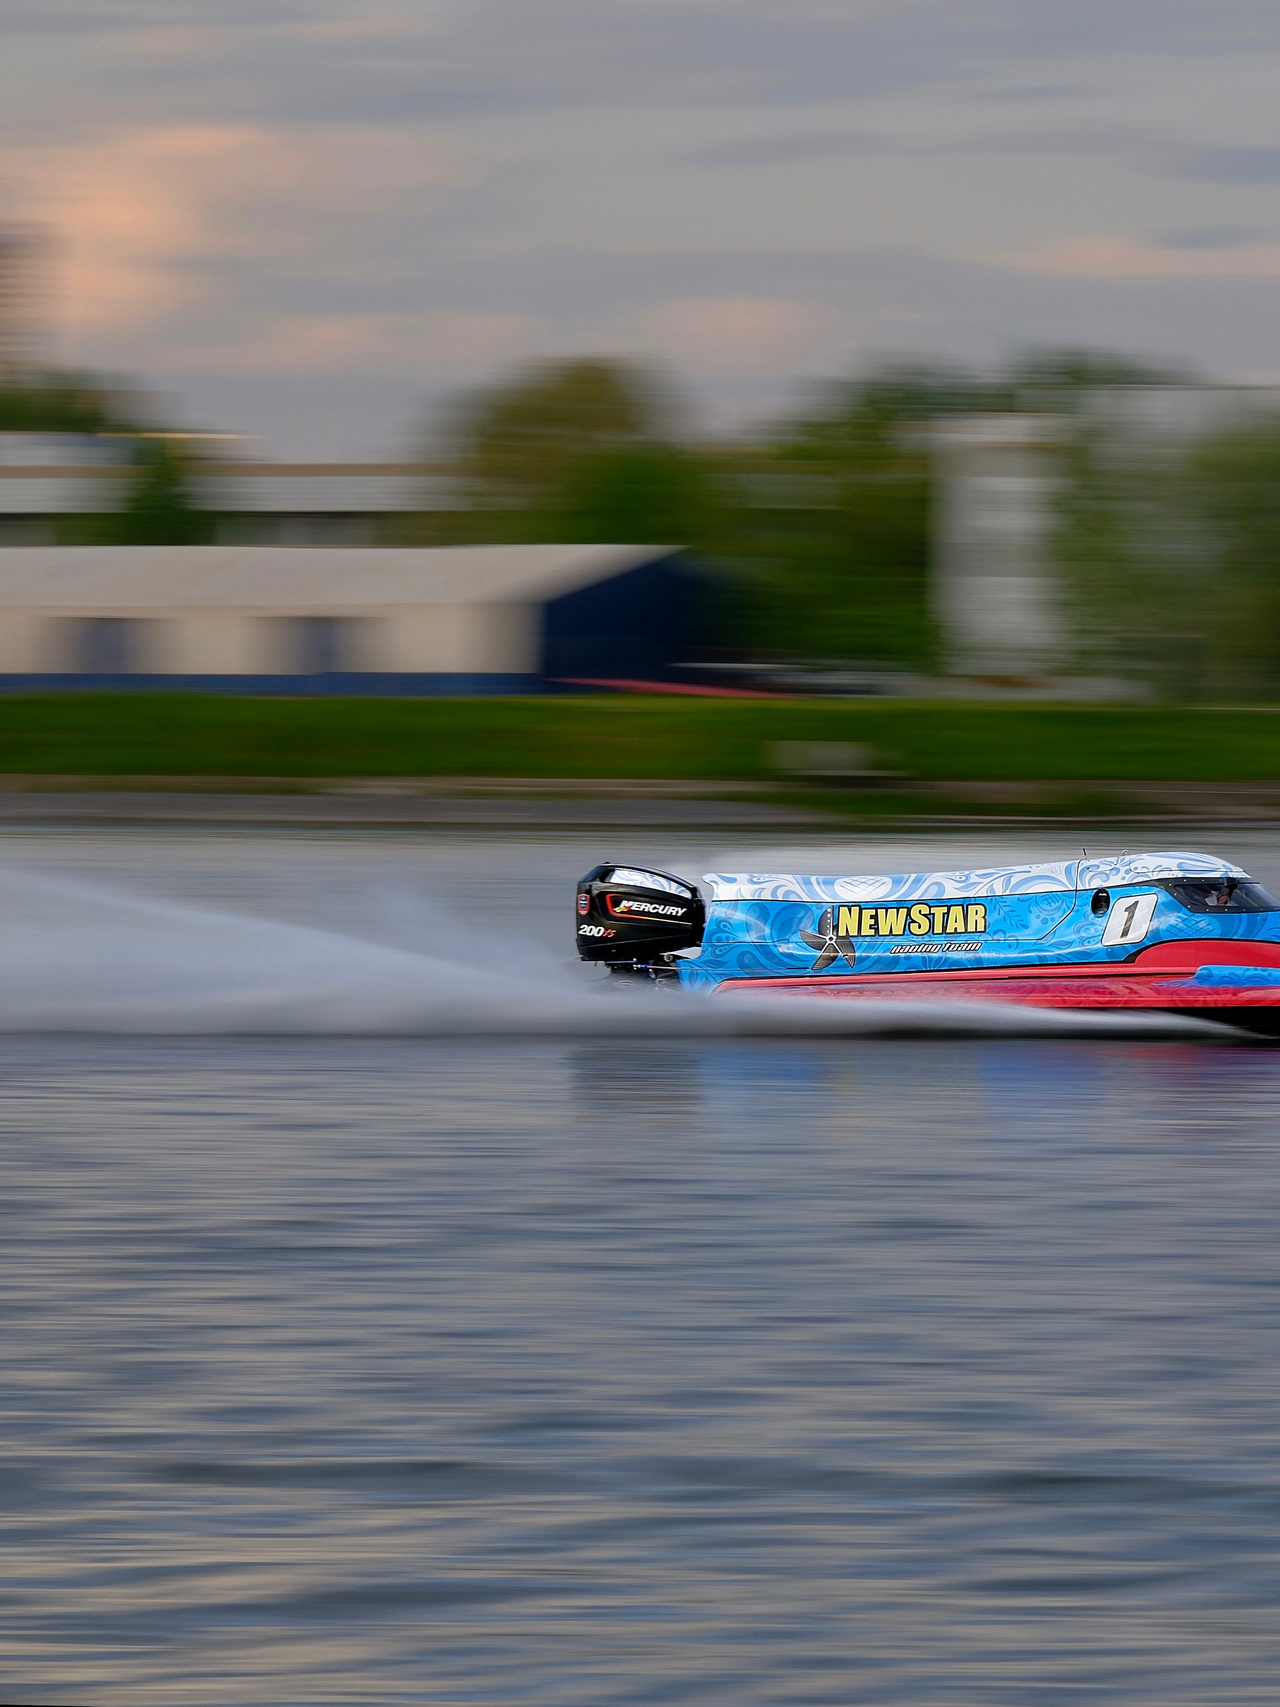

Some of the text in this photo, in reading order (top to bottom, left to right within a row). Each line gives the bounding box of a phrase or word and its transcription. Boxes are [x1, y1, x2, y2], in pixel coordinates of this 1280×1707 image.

[619, 900, 688, 917] MERCURY
[1120, 900, 1139, 939] 1
[942, 941, 983, 952] team
